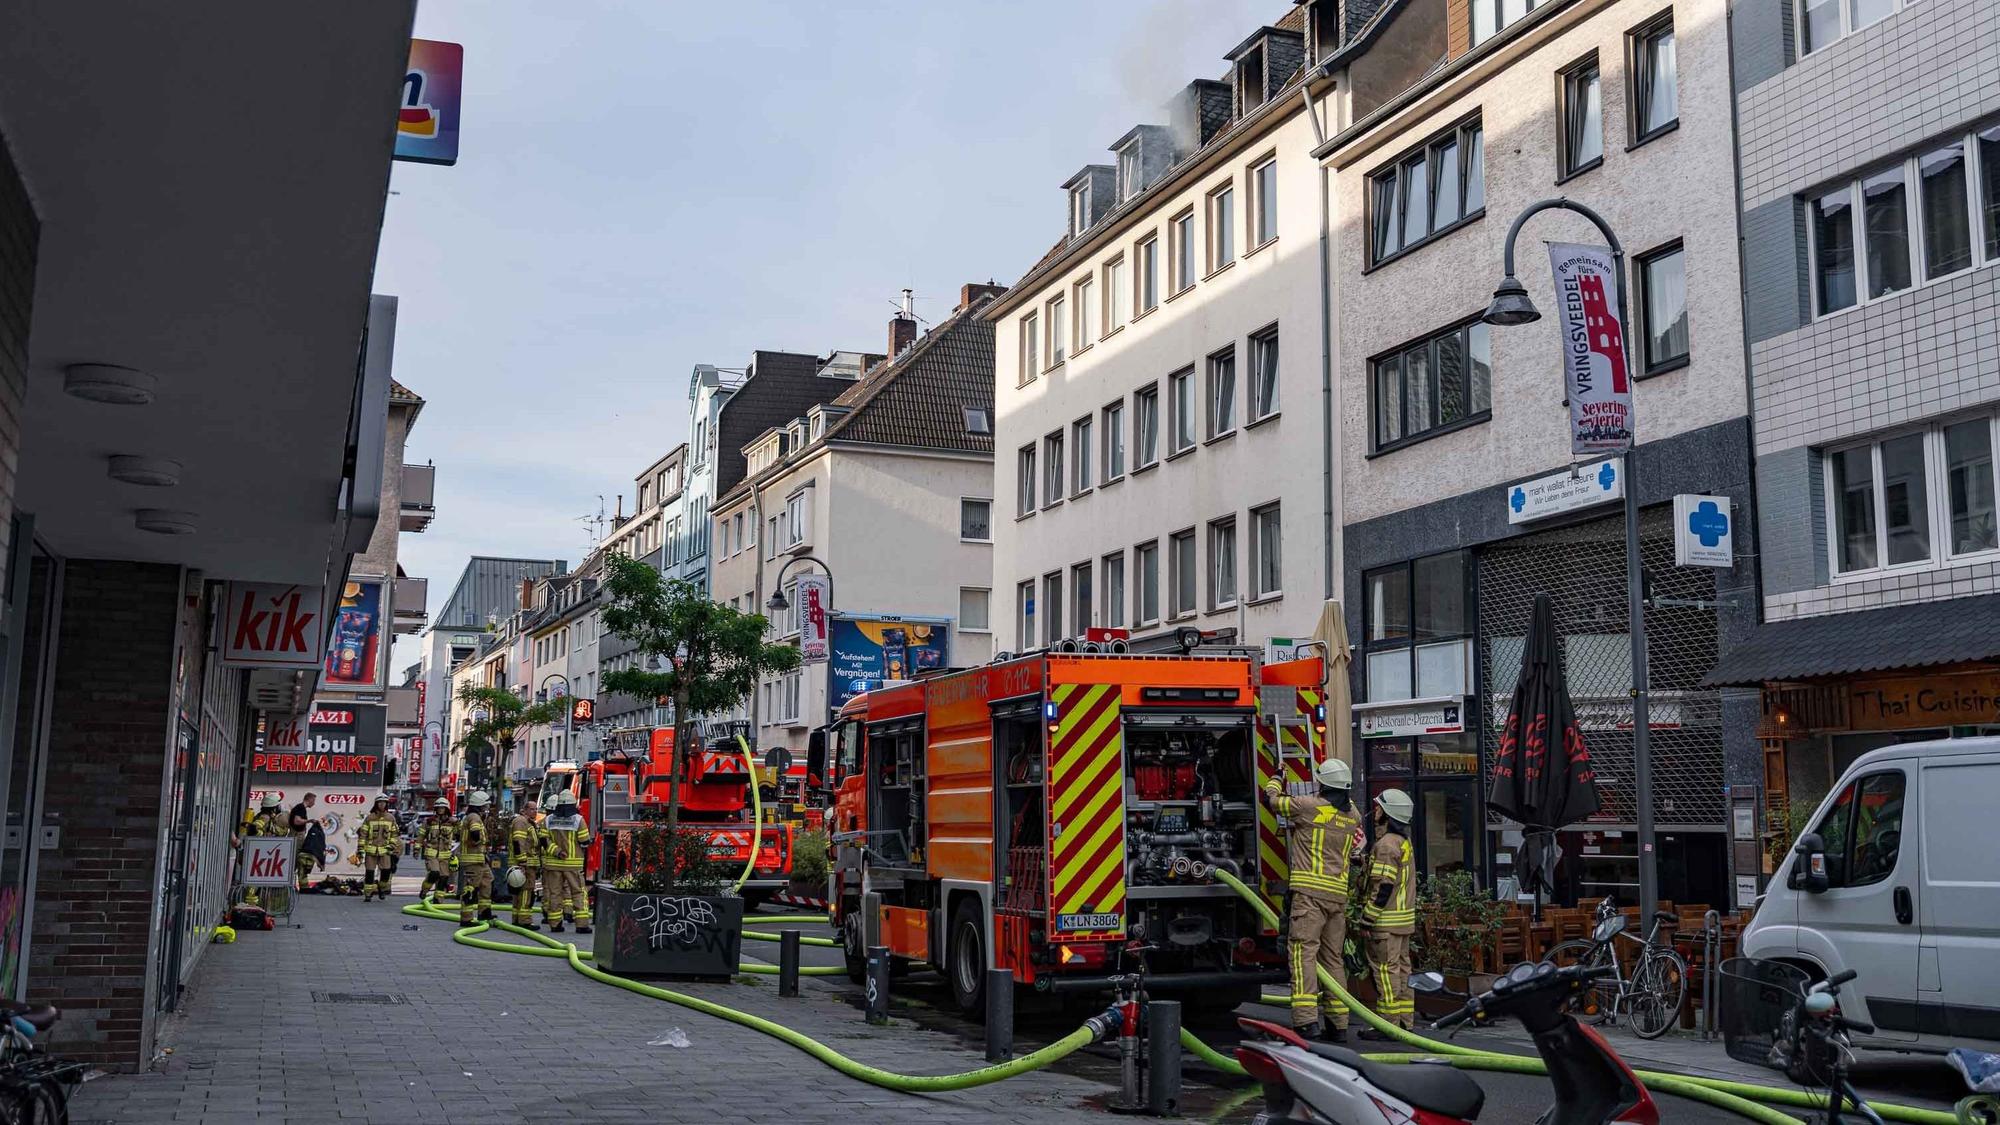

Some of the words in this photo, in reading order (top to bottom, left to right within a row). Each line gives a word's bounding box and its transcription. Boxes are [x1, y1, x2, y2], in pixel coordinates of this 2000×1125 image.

[1558, 256, 1611, 275] gemeinsam
[1578, 265, 1595, 274] fürs
[1564, 274, 1592, 395] VRINGSVEEDEL
[1529, 485, 1546, 498] mark
[840, 653, 876, 662] Aufstehen!
[834, 667, 881, 680] Vergnügen!
[1854, 690, 1910, 718] Thai
[1916, 688, 2000, 713] Cuisine
[309, 711, 348, 724] AZI
[328, 795, 361, 804] GAZI
[1092, 914, 1118, 926] 3806
